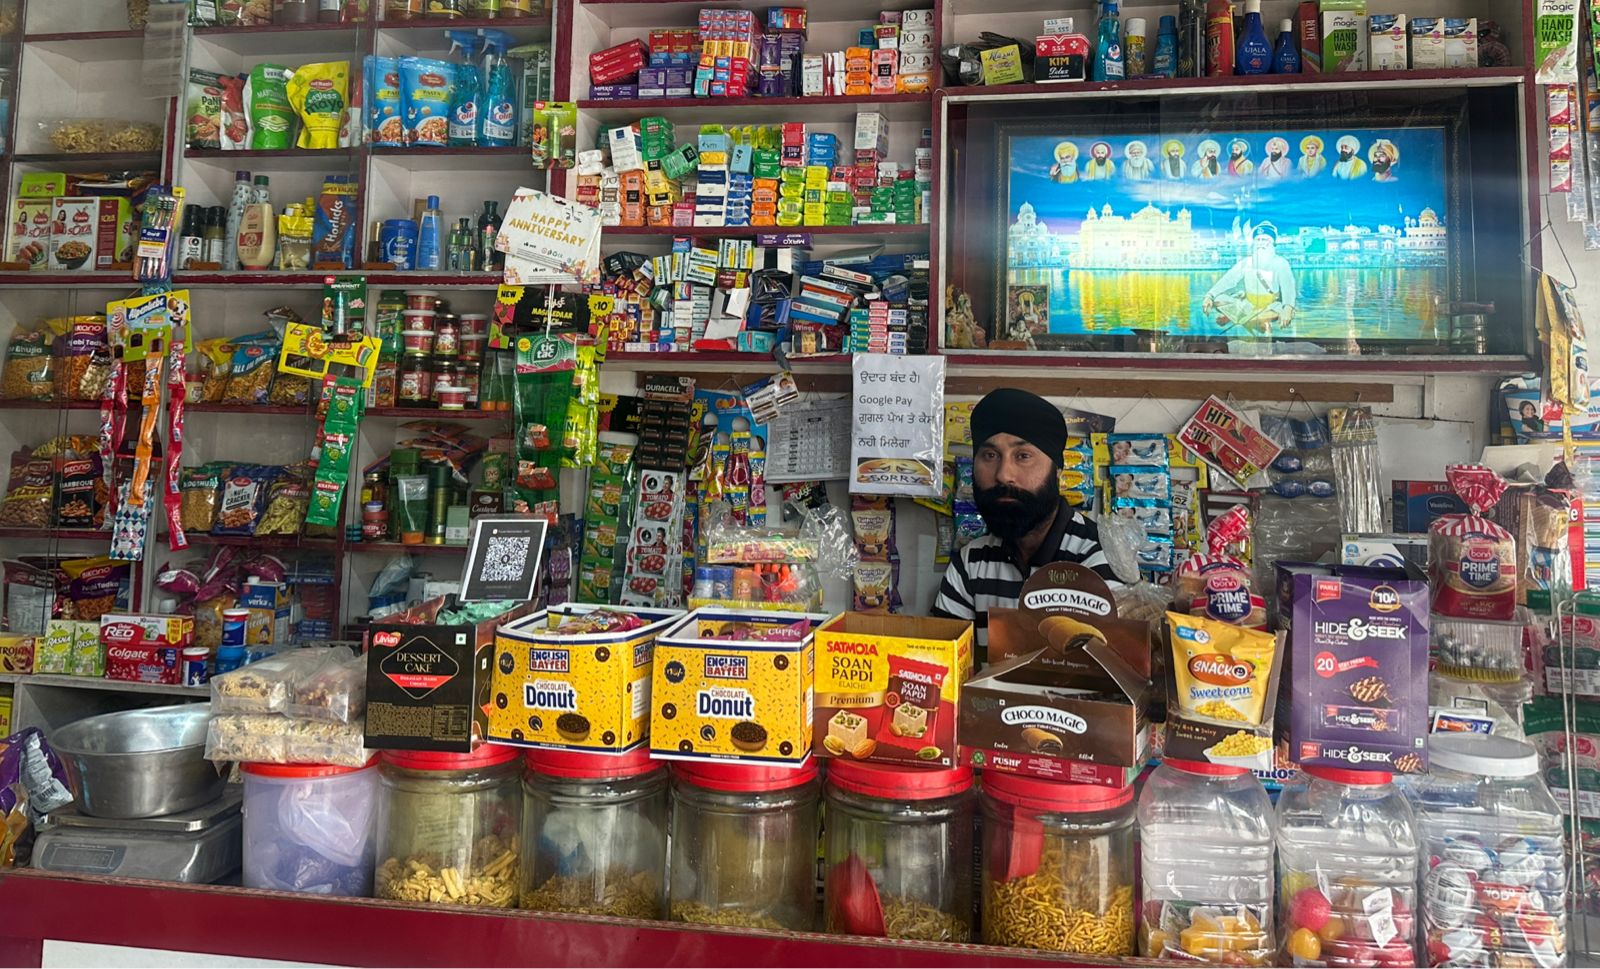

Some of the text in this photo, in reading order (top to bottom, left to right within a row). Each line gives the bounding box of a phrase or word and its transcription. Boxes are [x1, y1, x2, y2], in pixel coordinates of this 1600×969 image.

[1542, 3, 1574, 12] magic
[1333, 18, 1357, 27] magic
[1542, 19, 1573, 30] HAND
[1334, 32, 1357, 41] HAND
[1542, 31, 1572, 42] WASH
[1334, 42, 1357, 51] WASH
[1049, 57, 1069, 66] KIM
[325, 200, 343, 242] Horlicks
[531, 212, 571, 230] HAPPY
[509, 218, 586, 247] ANNIVERSARY
[501, 290, 517, 298] NEW
[541, 340, 555, 352] tic
[537, 349, 555, 360] tac
[860, 370, 887, 384] ਉਦਾਰ
[890, 370, 906, 383] ਬੰਦ
[645, 384, 681, 393] DURACELL
[859, 395, 913, 407] Google Pay
[1205, 406, 1232, 427] HIT
[1191, 427, 1212, 443] HIT
[858, 435, 911, 448] ਨਹੀ ਮਿਲੇਗਾ
[64, 463, 90, 473] BIKANO
[870, 474, 921, 483] SORRY
[234, 487, 244, 496] NUT
[226, 493, 250, 505] CRACKER
[646, 494, 670, 502] TOMATO
[472, 504, 497, 513] Custard
[1471, 548, 1491, 559] bonn
[81, 565, 111, 578] BIKANO
[1462, 562, 1498, 573] PRIME
[1469, 572, 1492, 582] TIME
[1212, 578, 1236, 589] bonn
[1320, 584, 1338, 592] PARLE
[248, 598, 268, 606] verka
[1027, 593, 1108, 613] CHOCO MAGIC
[1210, 592, 1249, 604] PRIME
[1216, 603, 1243, 613] TIME
[104, 626, 135, 638] RED
[46, 636, 71, 647] RASNA
[76, 639, 96, 649] RASNA
[108, 647, 149, 660] Colgate
[827, 641, 879, 656] SATMOLA
[396, 652, 442, 663] DESSERT
[531, 650, 567, 660] ENGLISH
[531, 660, 567, 670] BATTER
[706, 656, 745, 666] ENGLISH
[832, 656, 872, 669] SOAN
[1317, 658, 1334, 671] 20
[404, 662, 433, 673] CAKE
[706, 666, 745, 676] BATTER
[832, 668, 873, 682] PAPDI
[898, 669, 932, 684] SATMOLA
[536, 682, 568, 691] CHOCOLATE
[902, 681, 927, 691] SOAN
[526, 685, 575, 708] Donut
[711, 690, 745, 699] CHOCOLATE
[900, 687, 927, 699] PAPDI
[699, 692, 752, 717] Donut
[830, 694, 874, 705] Premium
[1004, 709, 1085, 732] CHOCO MAGIC
